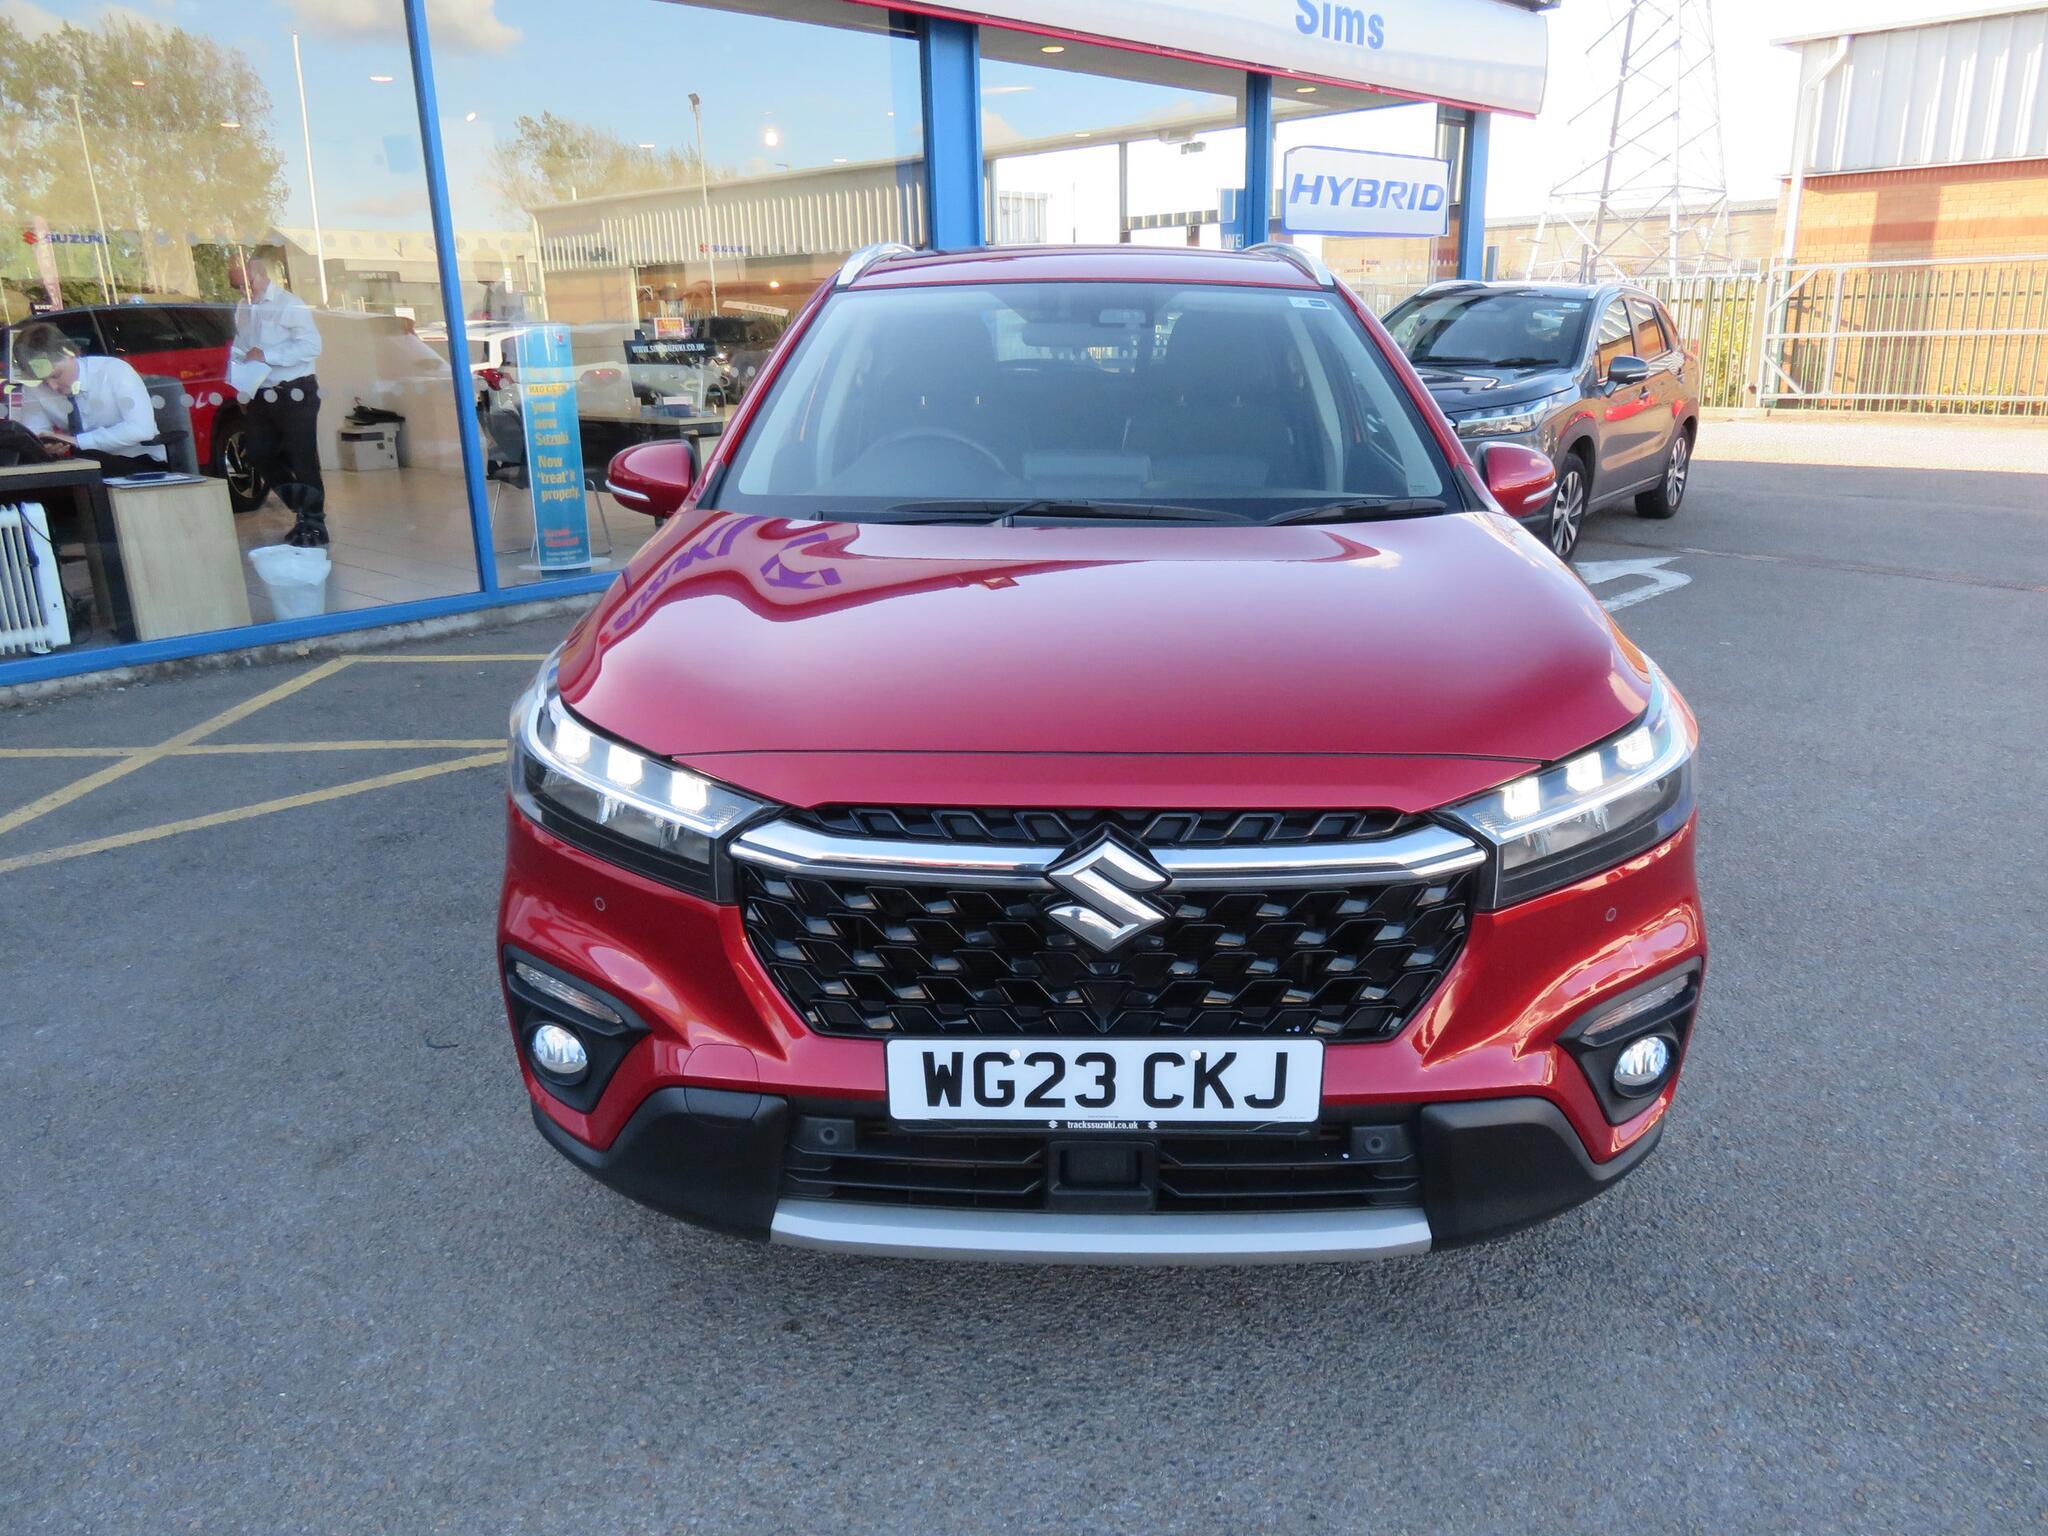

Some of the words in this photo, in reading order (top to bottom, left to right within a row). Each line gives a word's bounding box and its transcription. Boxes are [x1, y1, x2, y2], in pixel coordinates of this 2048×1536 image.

[1295, 0, 1384, 50] Sims
[1289, 173, 1445, 212] HYBRID
[922, 1051, 1116, 1108] WG23
[1142, 1052, 1289, 1109] CKJ
[1067, 1120, 1138, 1129] trackssuzuki.co.uk
